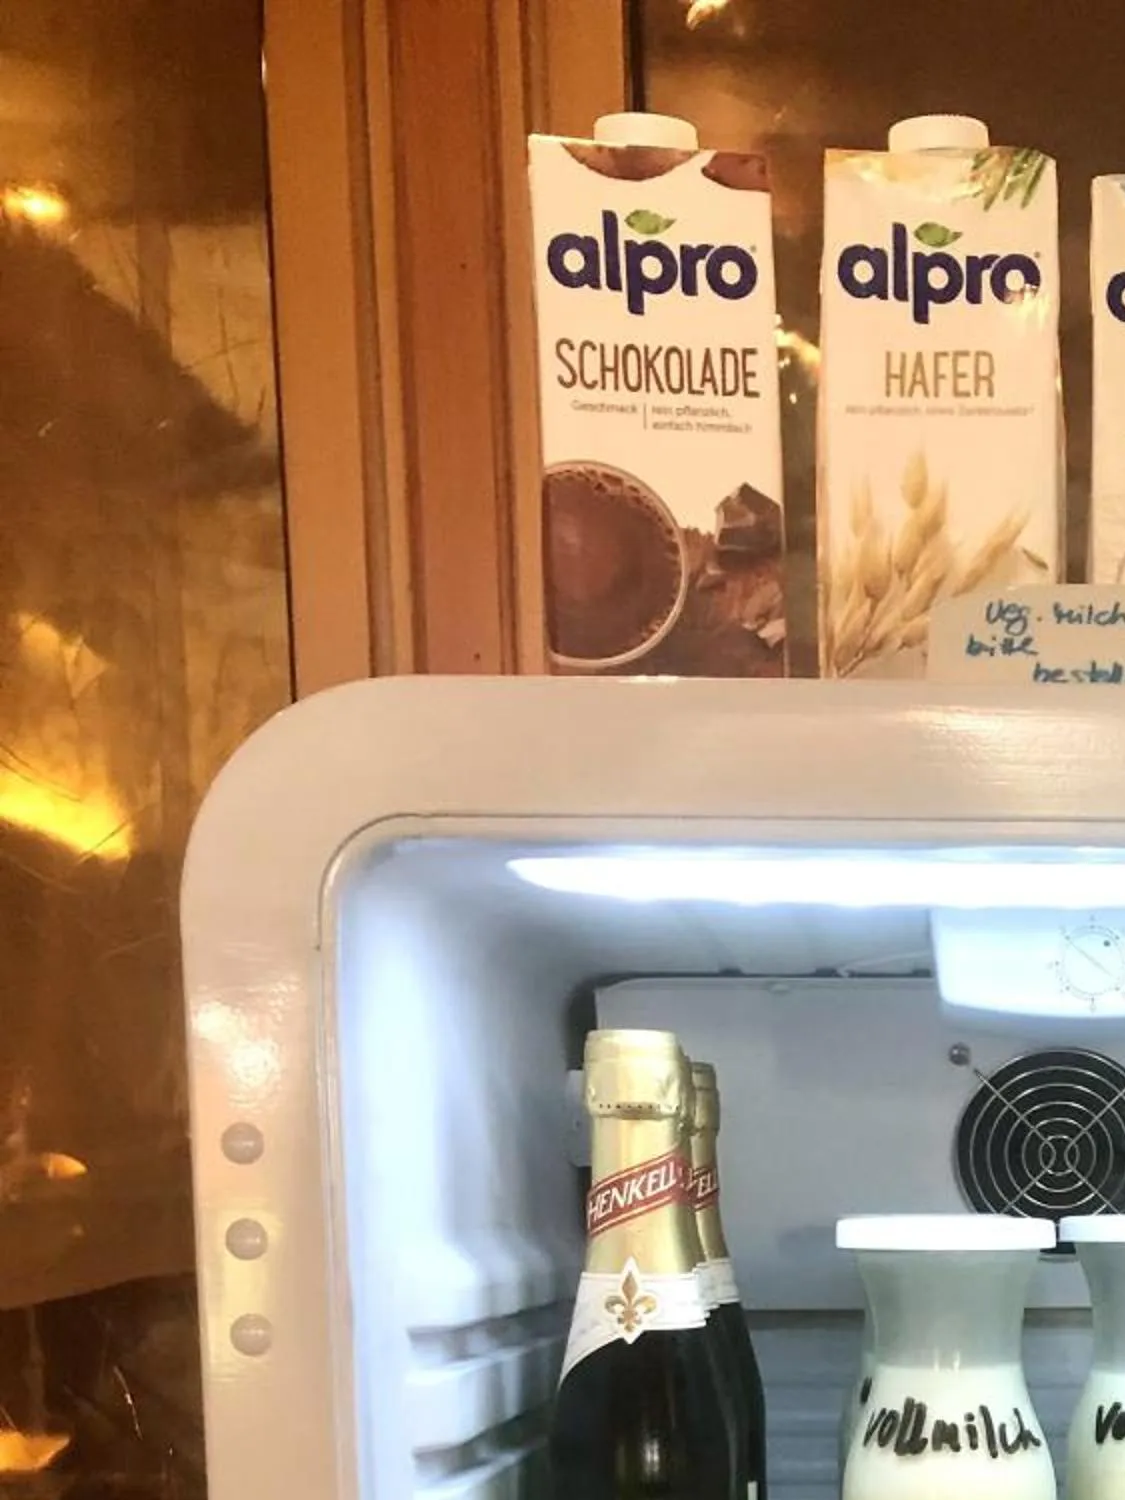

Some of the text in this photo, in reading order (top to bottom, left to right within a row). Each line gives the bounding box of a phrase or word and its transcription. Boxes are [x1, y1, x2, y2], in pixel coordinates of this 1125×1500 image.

[547, 210, 757, 316] alpro
[837, 223, 1041, 324] alpro
[555, 338, 760, 398] SCHOKOLADE
[885, 350, 995, 398] HAFER
[588, 1161, 677, 1229] HENKELL
